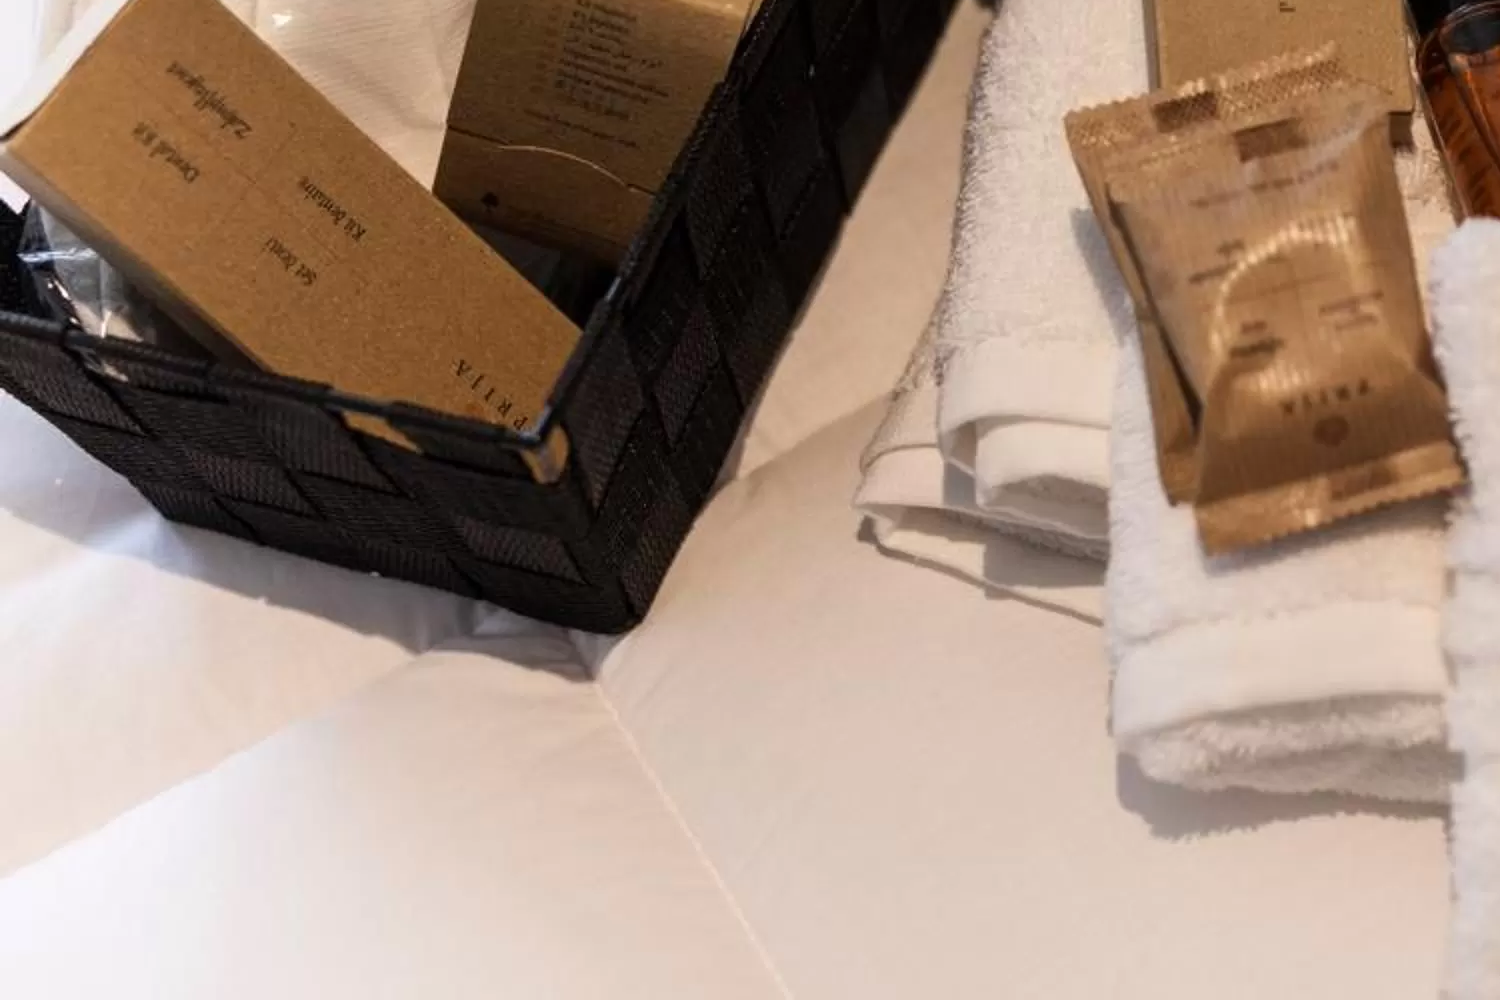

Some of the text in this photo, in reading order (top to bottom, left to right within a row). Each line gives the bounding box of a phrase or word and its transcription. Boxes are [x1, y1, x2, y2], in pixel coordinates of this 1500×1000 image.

[343, 216, 367, 243] Kit
[295, 262, 317, 287] Set
[450, 358, 528, 430] PRIJA
